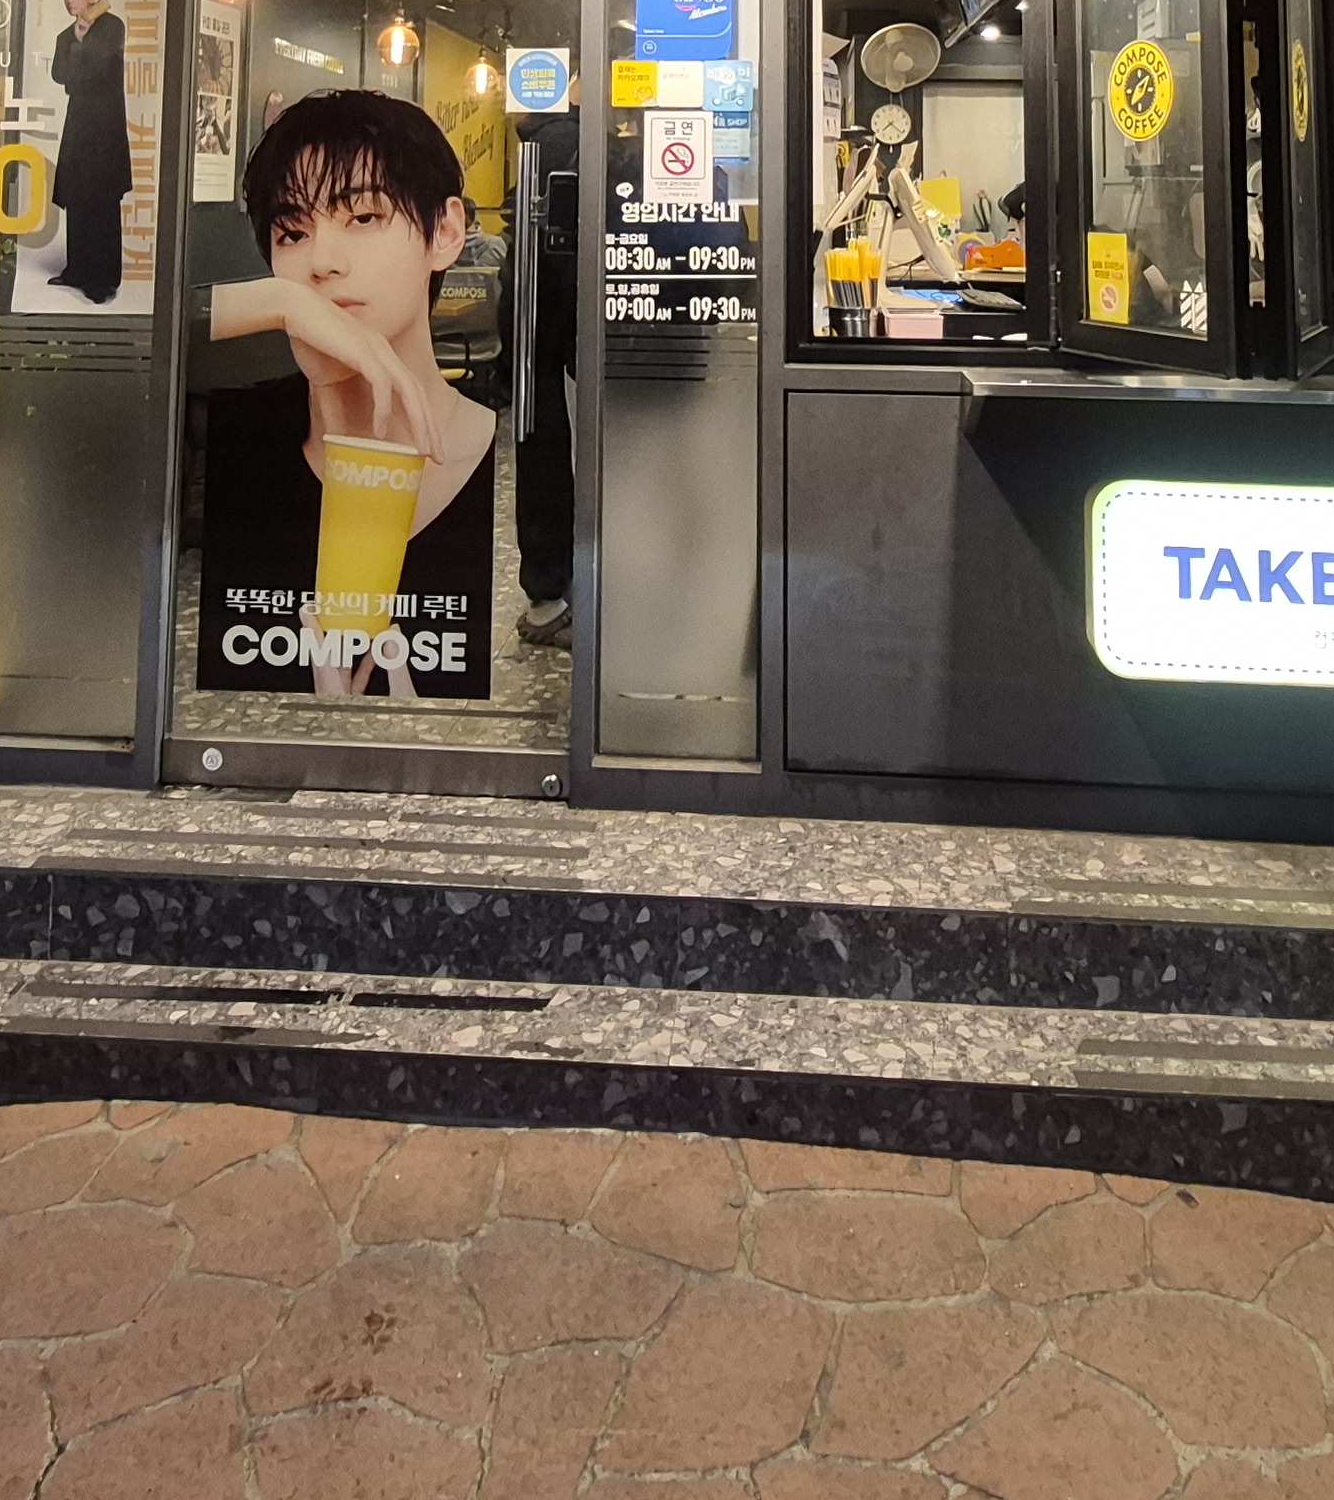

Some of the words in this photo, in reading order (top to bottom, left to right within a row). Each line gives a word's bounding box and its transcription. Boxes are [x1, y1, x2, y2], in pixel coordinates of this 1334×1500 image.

[1113, 47, 1168, 86] COMPOSE
[663, 121, 676, 136] 금
[681, 121, 694, 136] 연
[1117, 106, 1165, 134] COFFEE
[621, 202, 698, 223] 영업시간
[700, 202, 740, 223] 안내
[225, 587, 296, 617] 똑똑한
[373, 592, 417, 618] 커피
[422, 594, 467, 621] 루틴
[221, 624, 467, 673] COMPOSE
